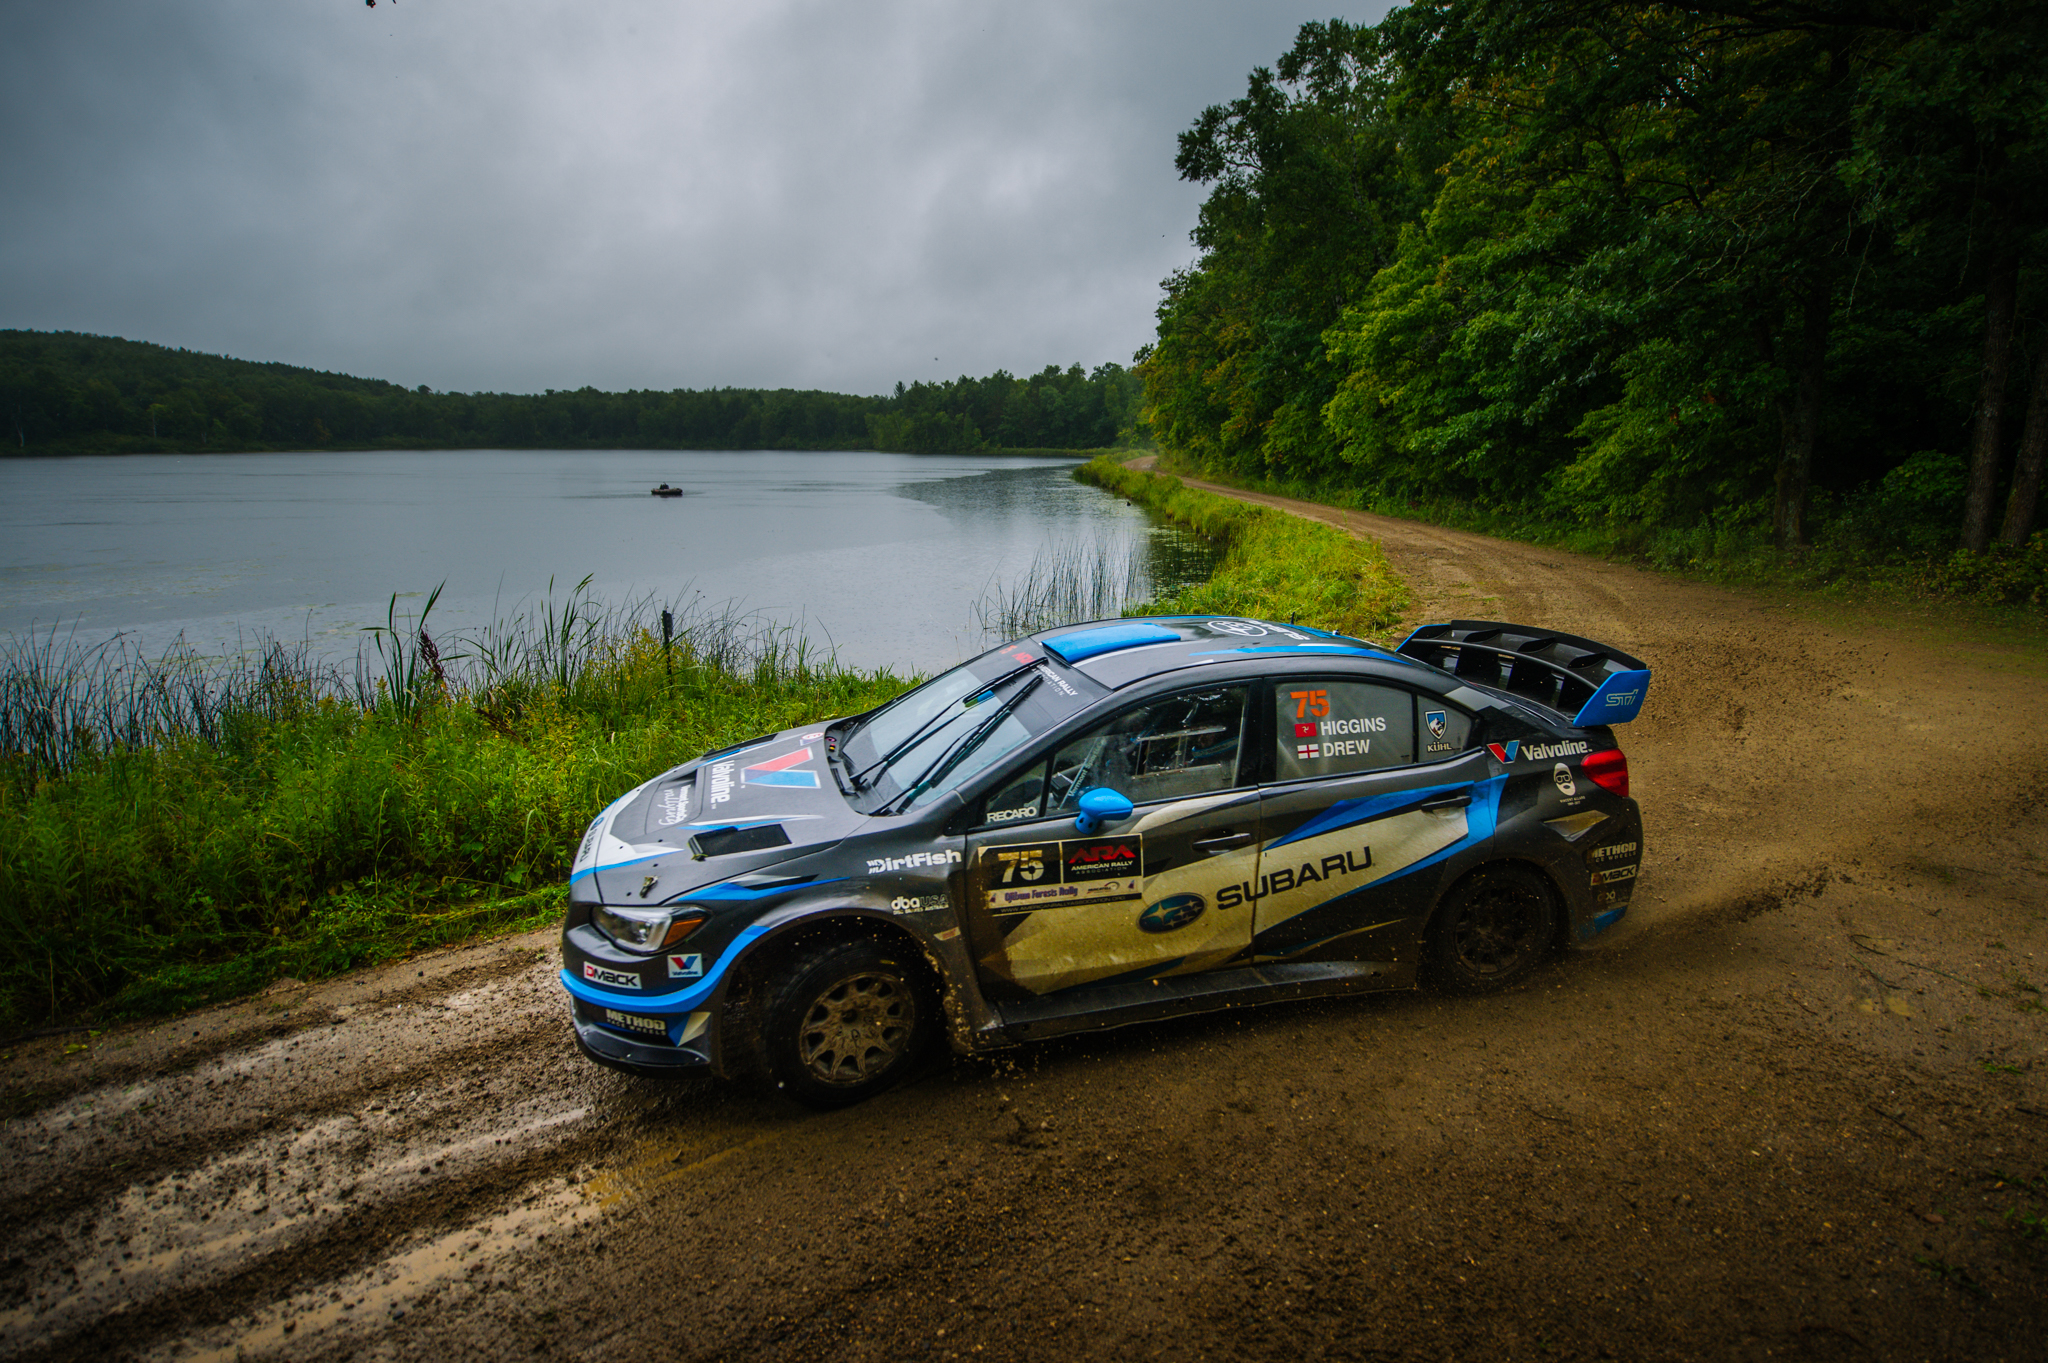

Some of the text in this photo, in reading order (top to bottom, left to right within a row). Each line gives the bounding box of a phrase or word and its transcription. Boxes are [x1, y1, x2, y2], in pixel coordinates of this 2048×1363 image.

[1011, 652, 1037, 665] AR
[1057, 678, 1078, 696] RALLY
[1290, 689, 1330, 718] 75
[1320, 717, 1387, 736] HIGGINS
[1323, 739, 1370, 757] DREW
[1427, 741, 1452, 752] KÜHL
[1521, 740, 1589, 761] Valvoline
[711, 760, 735, 804] Valvoline
[986, 806, 1037, 822] RECARO
[866, 849, 962, 874] DirtFish
[1068, 844, 1136, 864] ARA
[998, 850, 1044, 883] 75
[1071, 860, 1133, 871] AMERICAN RALLY
[1216, 846, 1372, 910] SUBARU
[1032, 888, 1057, 899] Forests
[1059, 885, 1078, 897] Rally
[606, 1009, 666, 1030] METHOD
